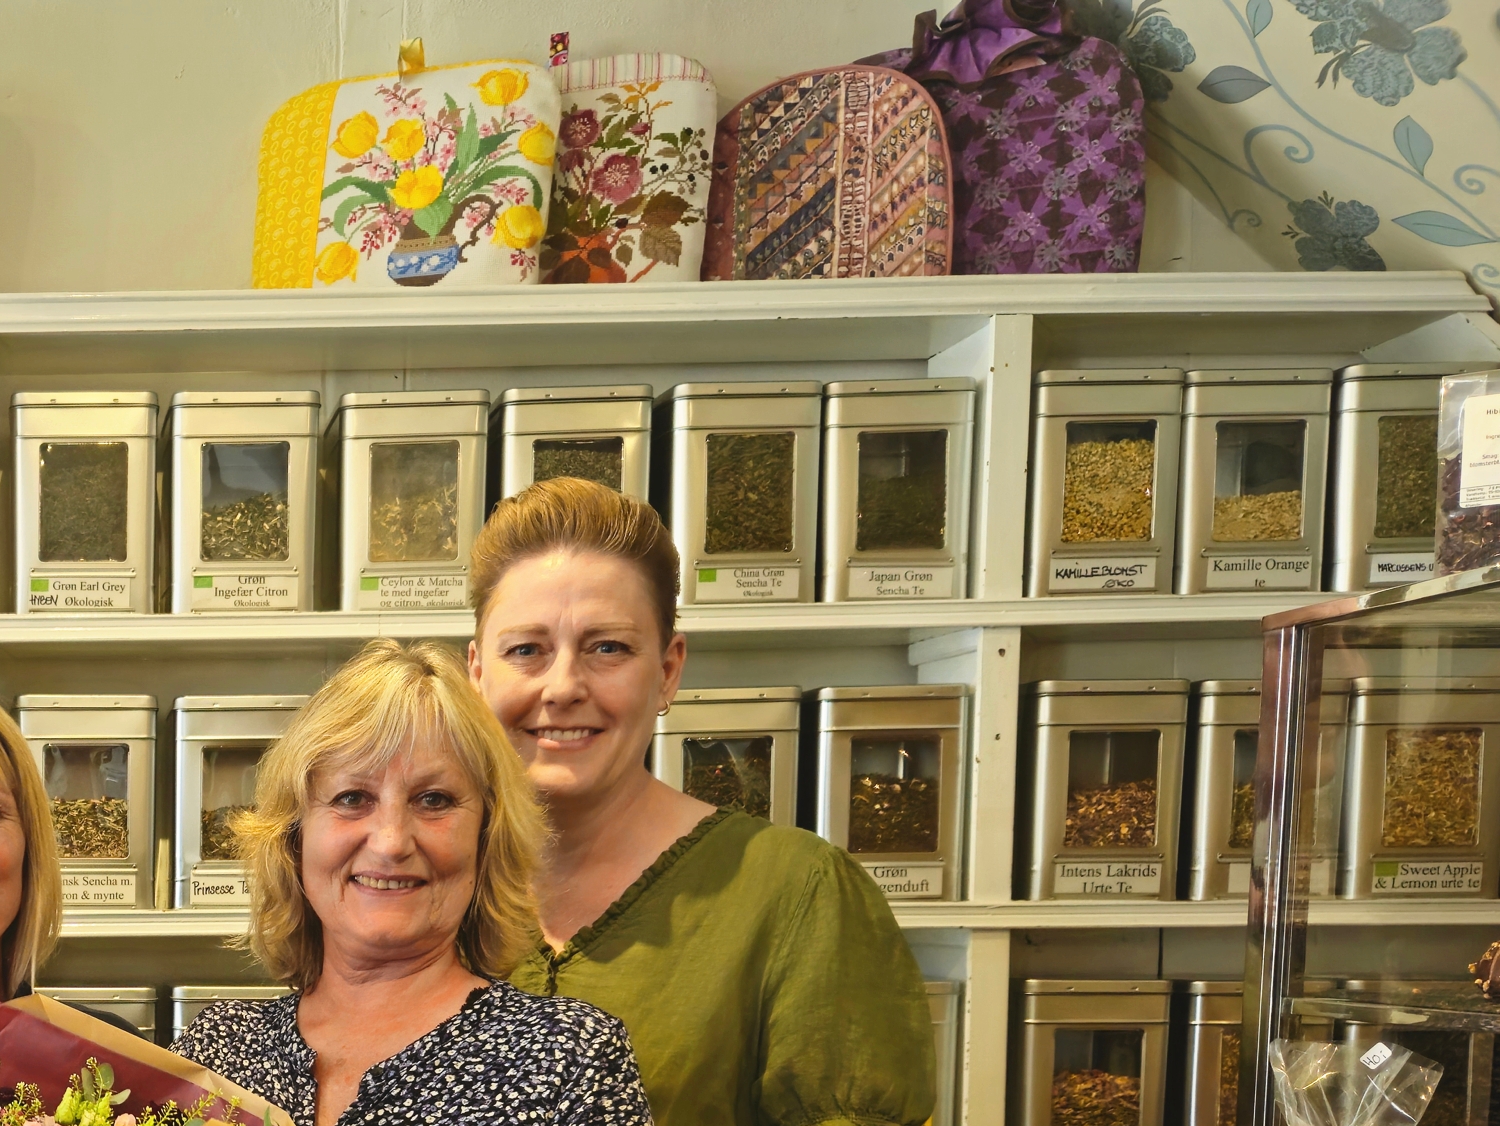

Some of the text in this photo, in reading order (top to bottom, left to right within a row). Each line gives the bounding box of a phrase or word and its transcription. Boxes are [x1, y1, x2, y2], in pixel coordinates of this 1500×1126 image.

[1213, 559, 1309, 573] Kamille Orange
[733, 568, 785, 577] China Grøn
[868, 570, 933, 584] Japan Grøn
[52, 581, 126, 593] Grøn Earl Grey
[381, 577, 463, 588] Ceylon & Matcha
[736, 578, 782, 587] Sencha Te
[214, 586, 289, 598] Ingefær Citron
[391, 588, 449, 599] med ingefær
[876, 585, 924, 595] Sencha Te
[65, 596, 113, 608] Økologisk
[234, 599, 270, 607] Økologisk
[873, 866, 908, 879] Grøn
[1060, 863, 1157, 878] Intens Lakrids
[1400, 864, 1480, 878] Sweet Apple
[82, 876, 133, 886] Sencha m.
[1082, 881, 1132, 893] Urte Te
[1374, 877, 1480, 889] & Lemon urte te
[192, 880, 235, 896] Prinsesse
[81, 889, 124, 902] & mynte
